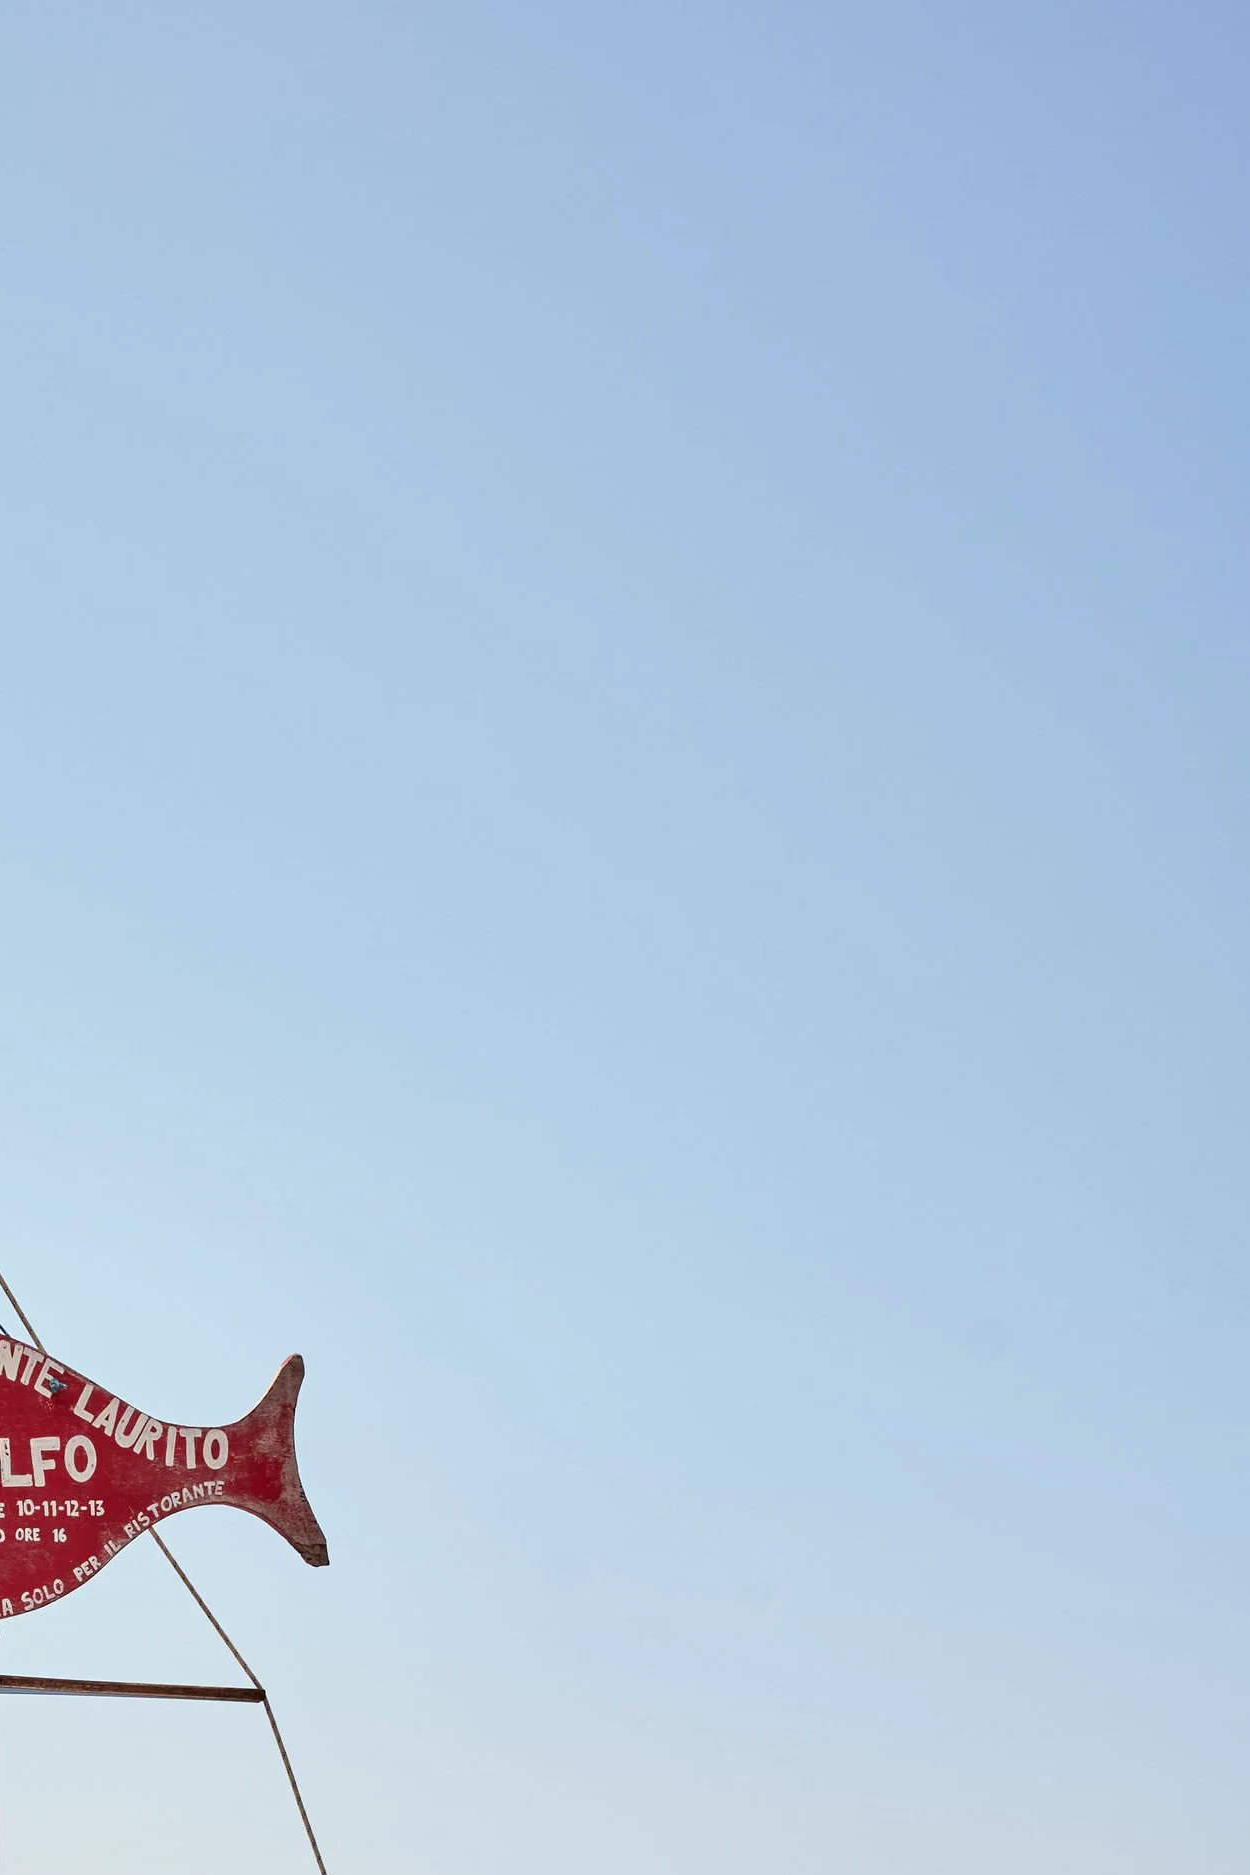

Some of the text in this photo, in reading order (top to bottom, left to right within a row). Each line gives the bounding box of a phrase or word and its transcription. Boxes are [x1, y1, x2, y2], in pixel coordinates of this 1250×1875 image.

[73, 1384, 229, 1469] LAURITO
[16, 1499, 105, 1517] 10-11-12-13
[15, 1528, 41, 1542] ORE
[52, 1528, 67, 1543] 16
[20, 1579, 65, 1611] SOLO
[72, 1555, 102, 1583] PER
[103, 1540, 121, 1557] IL
[123, 1481, 225, 1539] RISTORANTE
